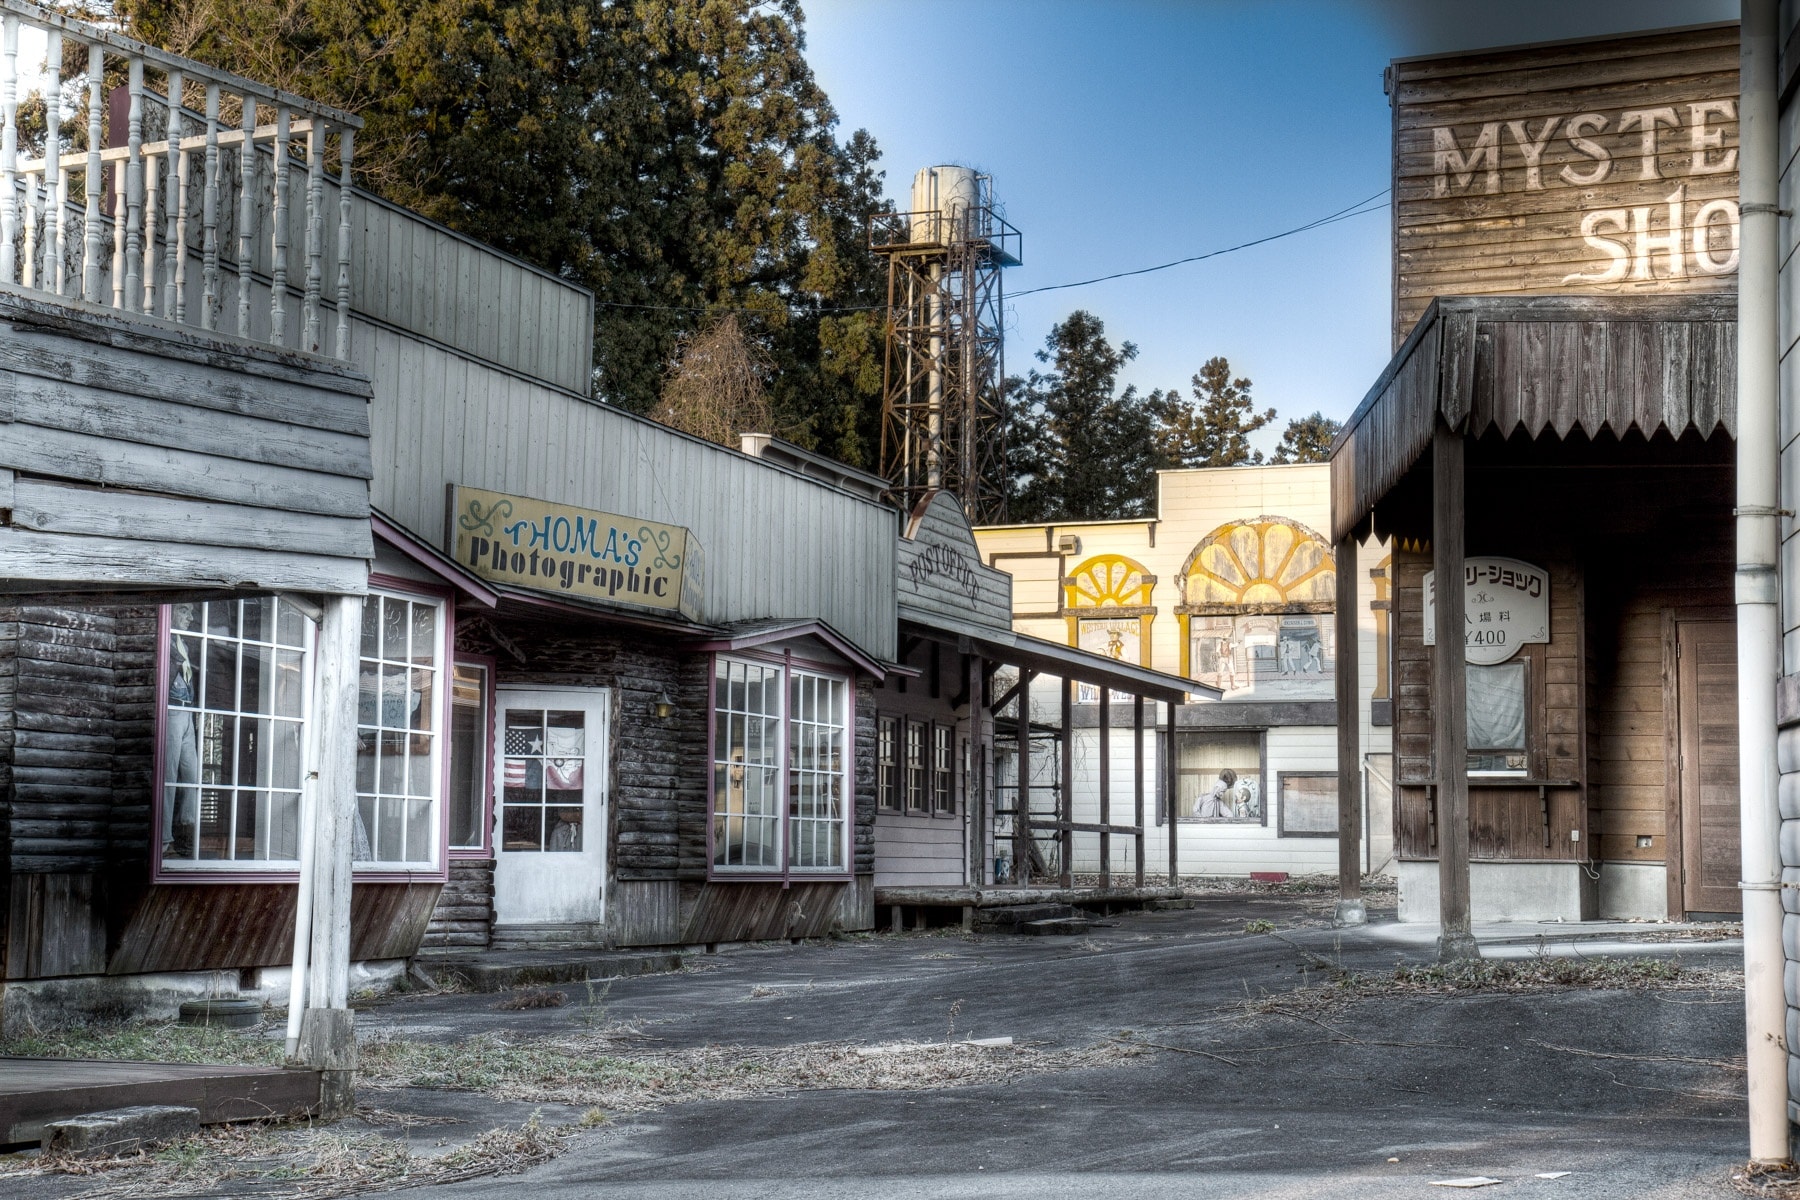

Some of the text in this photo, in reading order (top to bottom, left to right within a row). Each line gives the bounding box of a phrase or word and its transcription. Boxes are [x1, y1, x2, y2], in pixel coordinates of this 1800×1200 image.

[1432, 99, 1740, 199] MYSTE
[1561, 185, 1740, 288] SHO
[470, 536, 669, 598] Photographic
[503, 514, 643, 567] THOMA'S
[909, 543, 980, 609] POST OFFICE
[1430, 565, 1542, 606] リーショック
[1080, 684, 1100, 700] WIL
